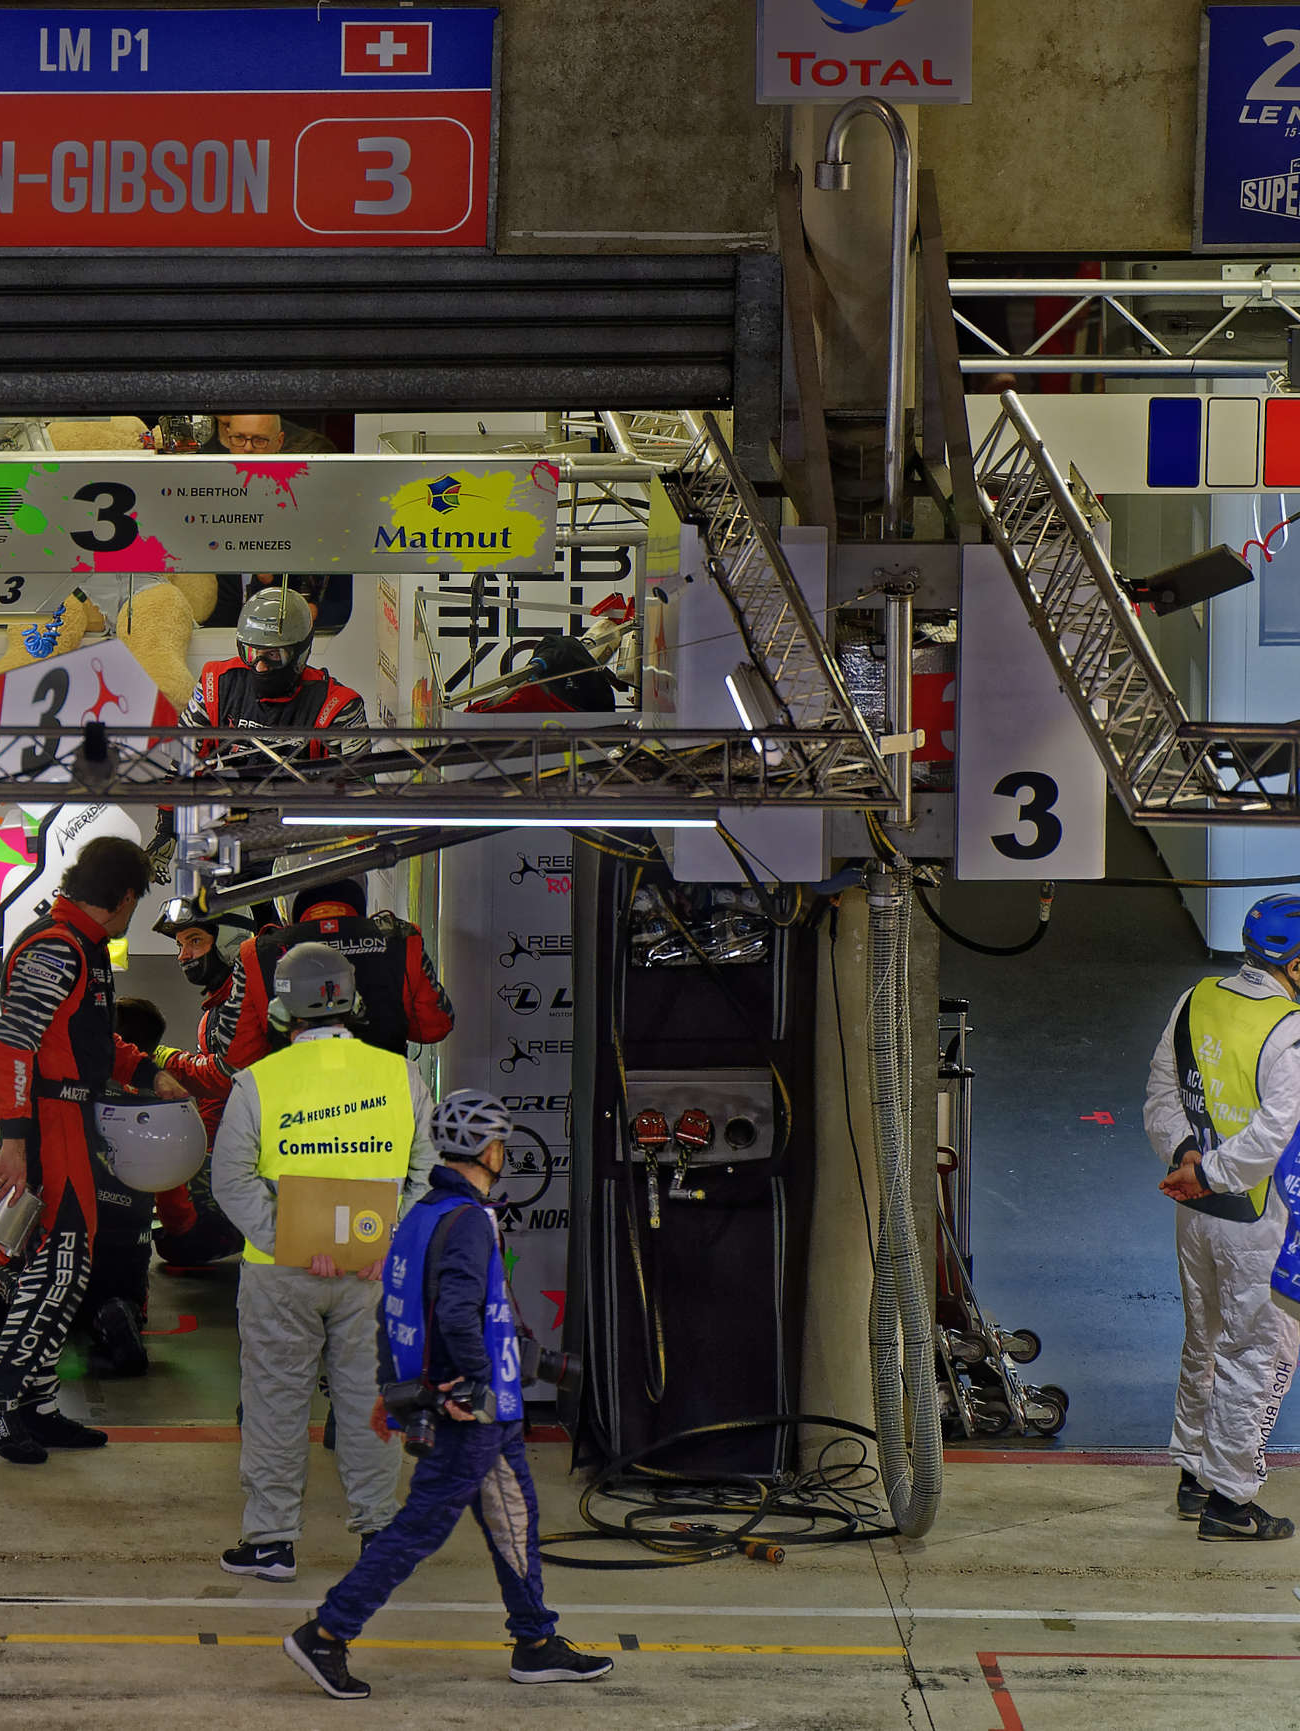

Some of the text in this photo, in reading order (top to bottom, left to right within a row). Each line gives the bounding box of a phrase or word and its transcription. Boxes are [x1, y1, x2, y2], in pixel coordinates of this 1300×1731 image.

[39, 27, 150, 73] LM P1
[776, 51, 954, 87] TOTAL
[1238, 105, 1282, 124] LE
[354, 136, 413, 216] 3
[190, 487, 249, 497] BERTHON
[70, 481, 138, 552] 3
[200, 513, 264, 524] T. LAURENT
[224, 540, 292, 551] G. MENEZES
[374, 525, 512, 549] Matmut
[21, 667, 70, 774] 3
[990, 771, 1063, 860] 3
[279, 1095, 387, 1130] 24 HEURES DU MANS
[278, 1136, 393, 1156] Commissaire
[10, 1231, 76, 1367] REBELLION
